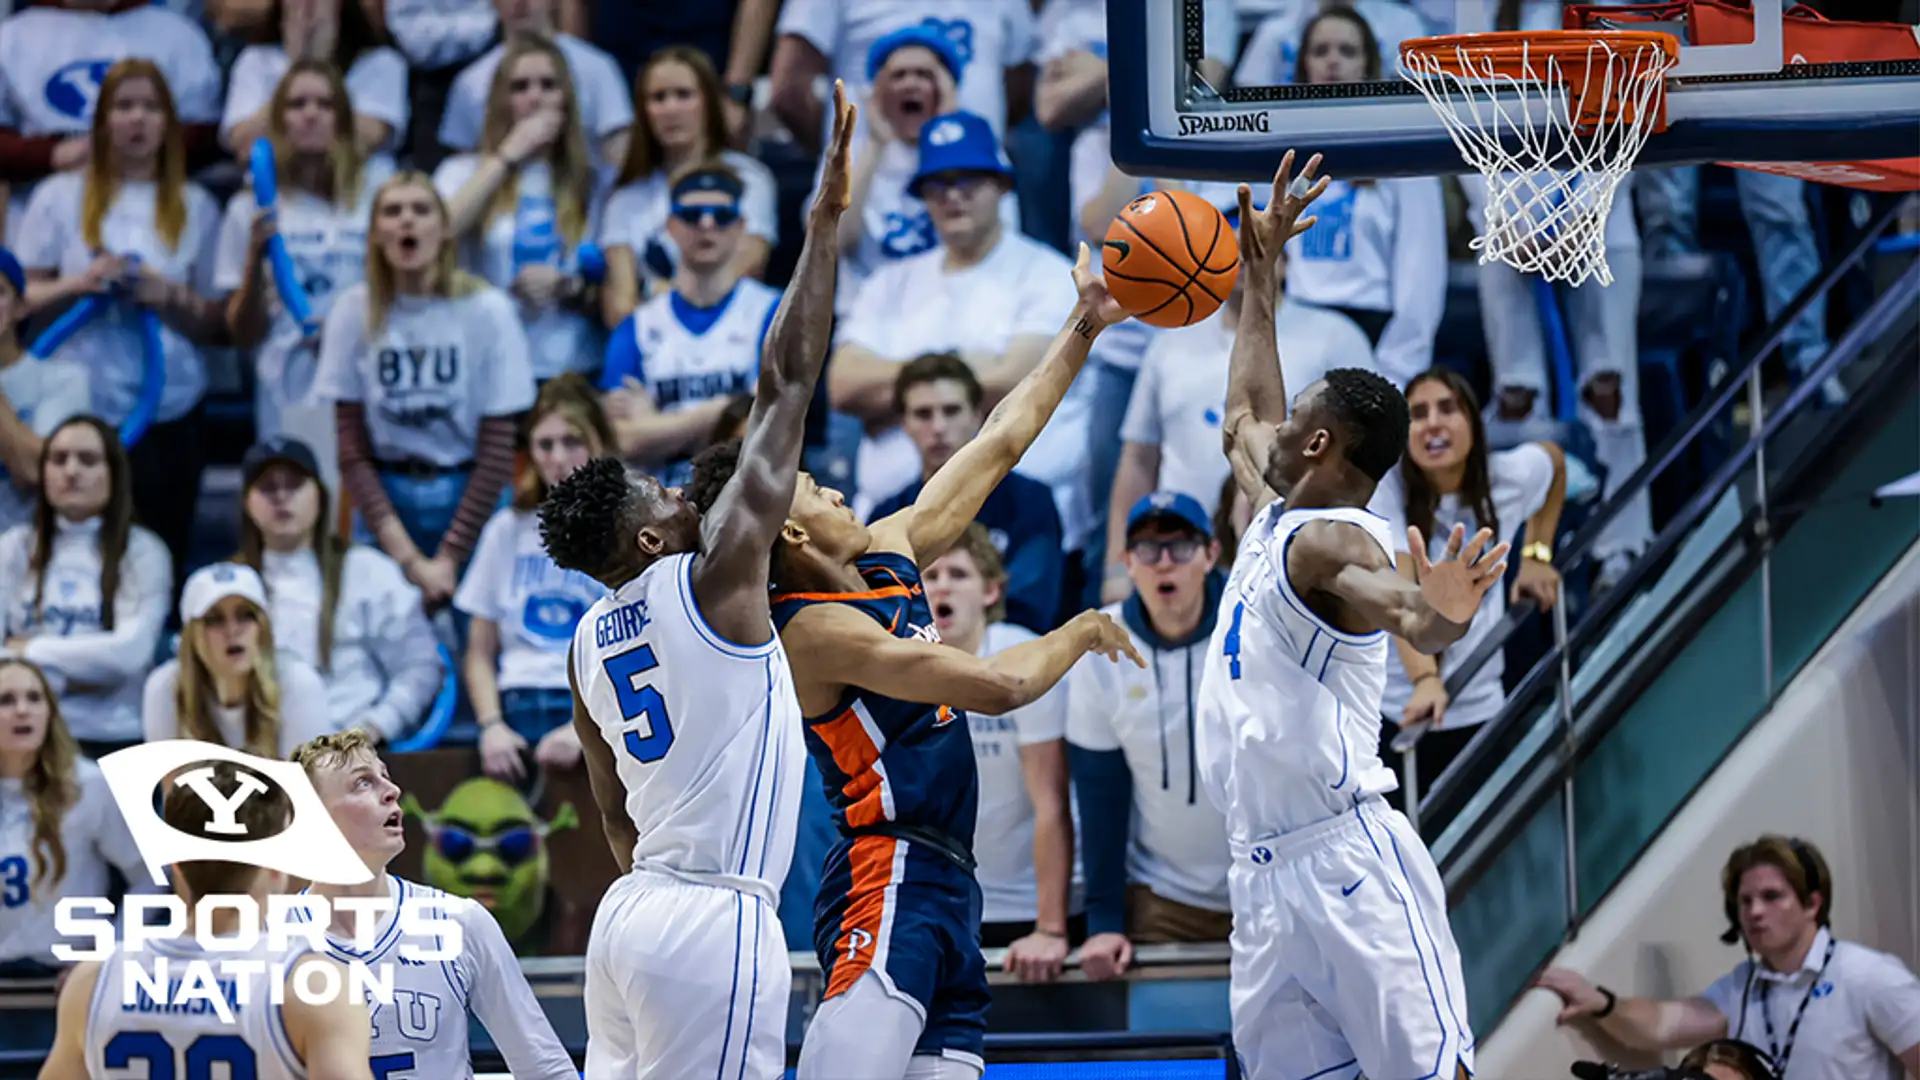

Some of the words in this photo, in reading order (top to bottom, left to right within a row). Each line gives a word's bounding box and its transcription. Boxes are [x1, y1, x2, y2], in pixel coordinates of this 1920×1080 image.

[1178, 110, 1271, 137] SPALDING
[379, 346, 457, 388] BYU
[1223, 600, 1242, 680] 4
[602, 643, 675, 764] 5
